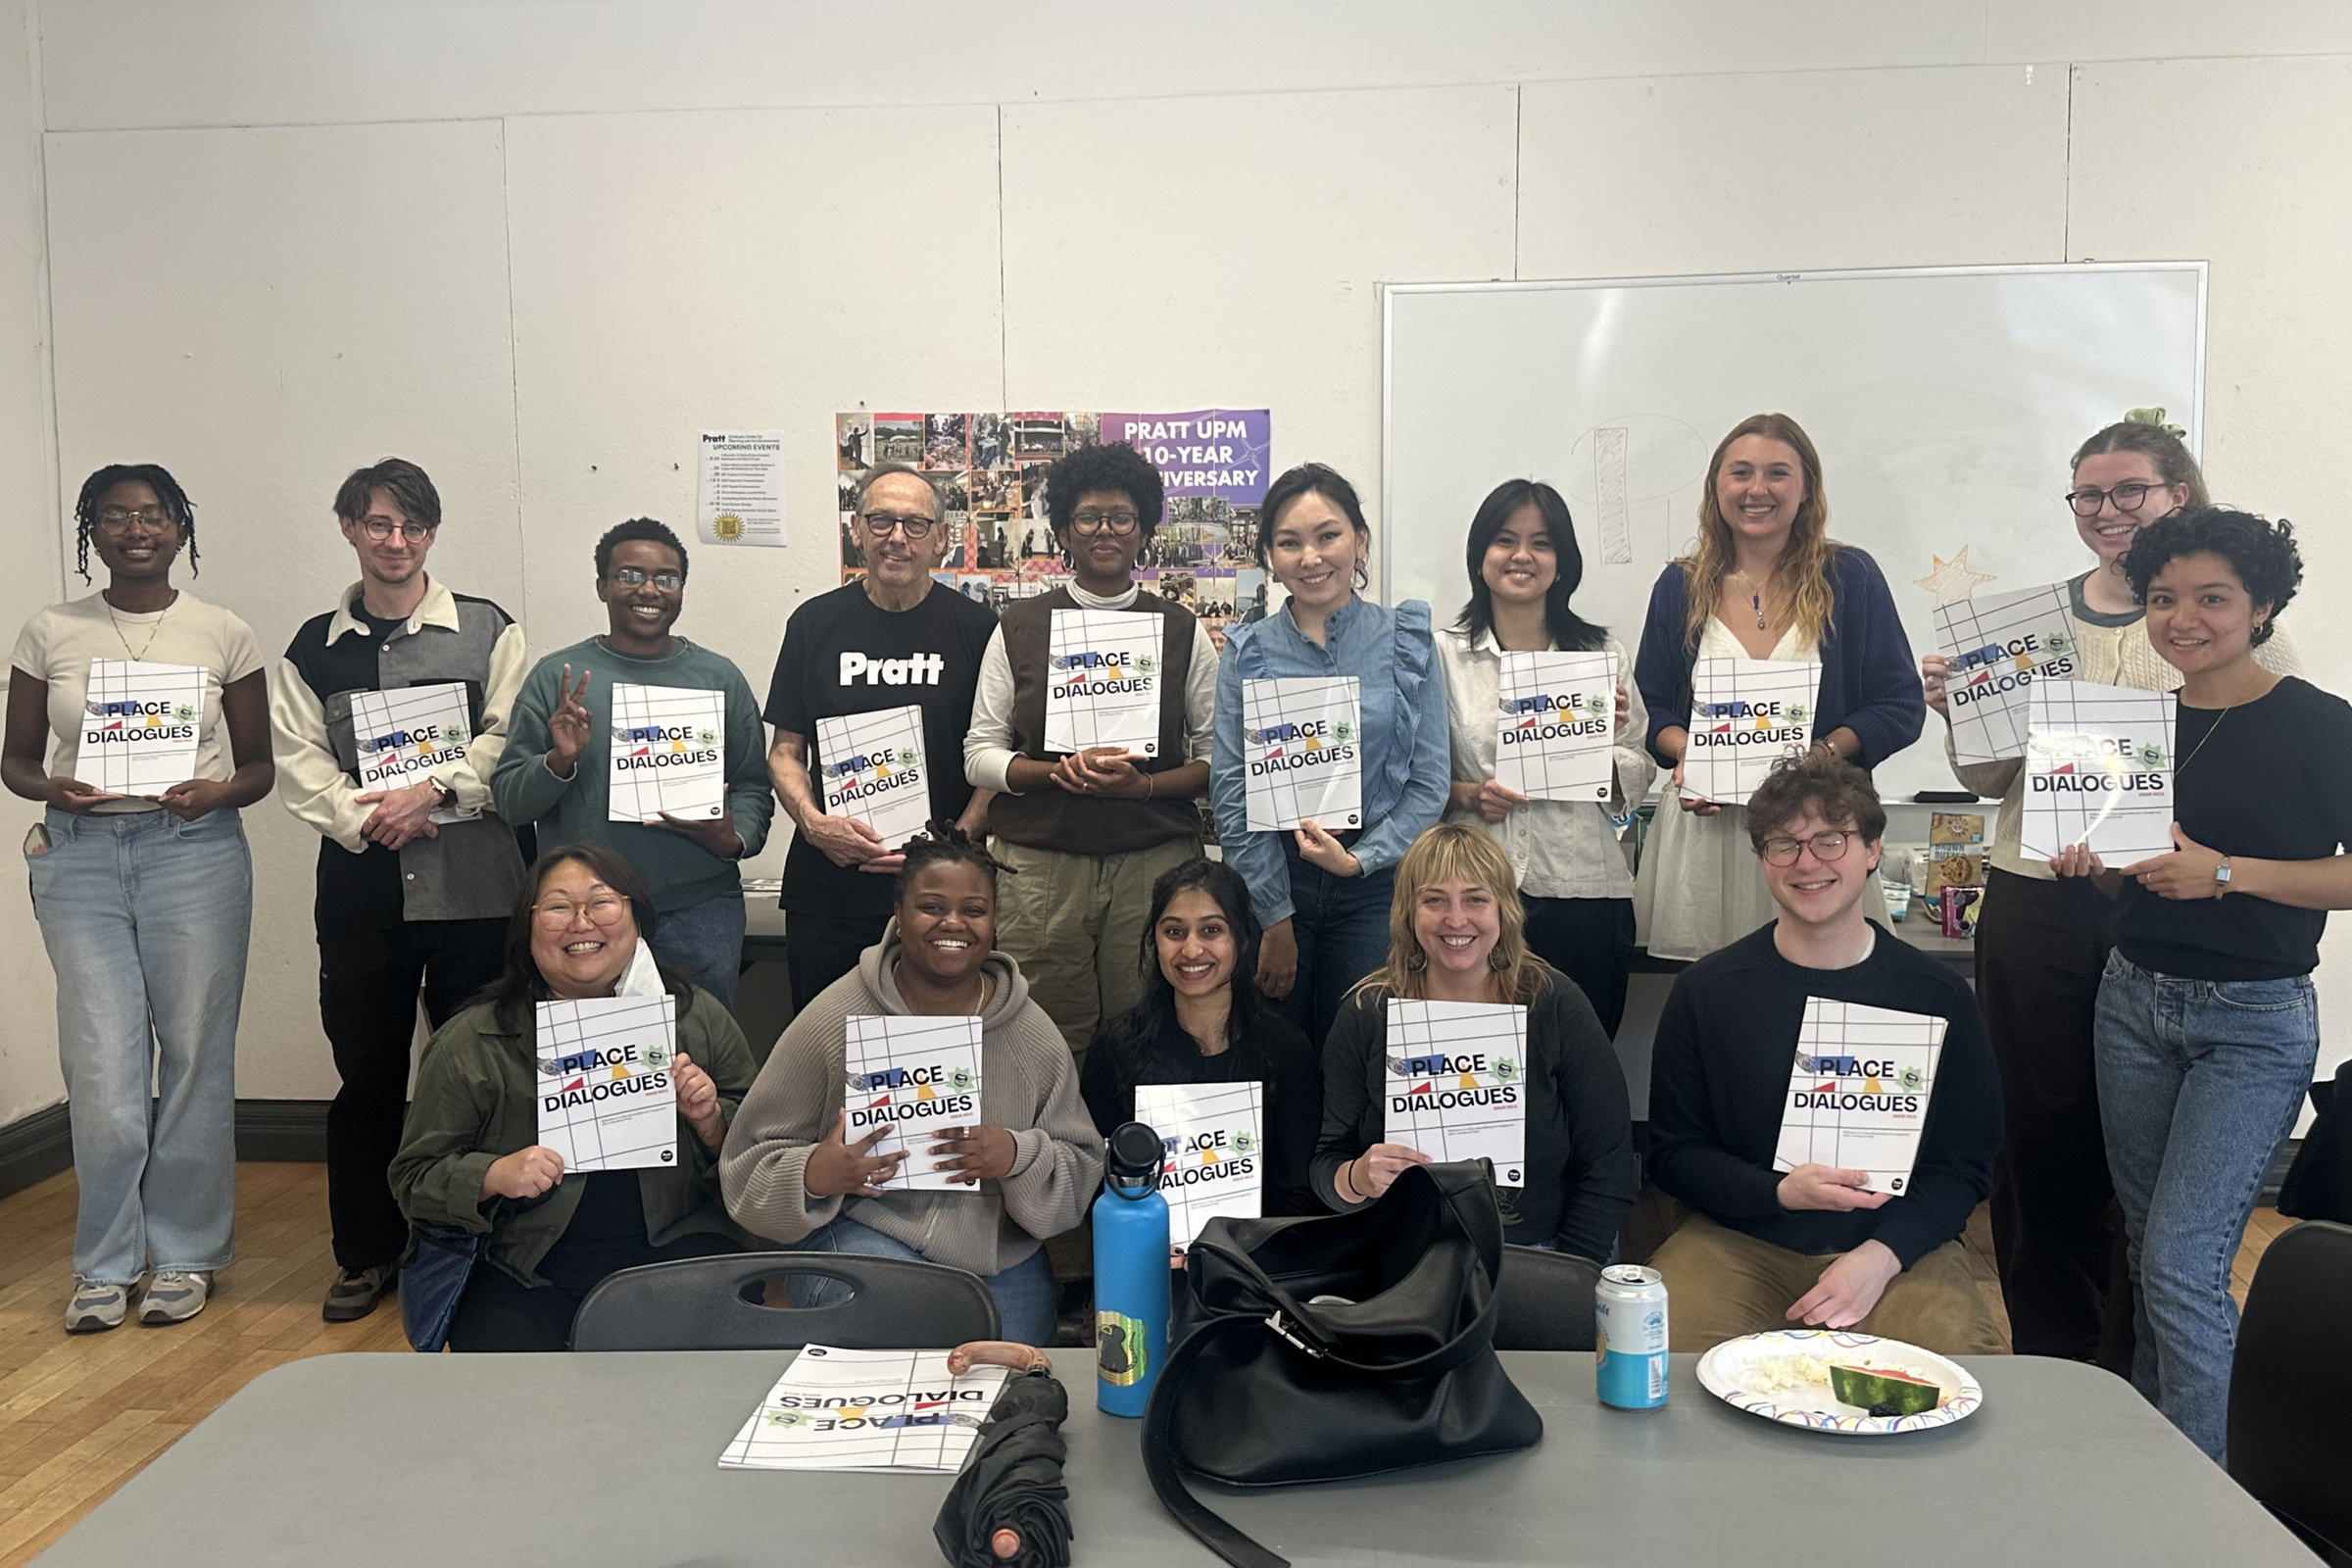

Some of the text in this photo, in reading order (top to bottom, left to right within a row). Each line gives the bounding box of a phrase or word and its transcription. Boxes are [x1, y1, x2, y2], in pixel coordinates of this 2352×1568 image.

[703, 434, 726, 443] Pratt
[1124, 420, 1248, 440] PRATT UPM
[1143, 446, 1234, 465] 10-YEAR
[1158, 469, 1259, 487] IVERSARY
[1069, 652, 1131, 669] PLACE
[1965, 634, 2039, 670] PLACE
[840, 652, 945, 686] Pratt
[1054, 677, 1153, 699] DIALOGUES
[108, 702, 171, 717] PLACE
[1519, 693, 1583, 714] PLACE
[1715, 702, 1781, 718] PLACE
[87, 726, 193, 744] DIALOGUES
[377, 725, 439, 752] PLACE
[633, 726, 693, 743] PLACE
[1266, 720, 1328, 744] PLACE
[1502, 719, 1607, 745] DIALOGUES
[1694, 727, 1804, 747] DIALOGUES
[366, 746, 466, 782] DIALOGUES
[616, 750, 717, 770] DIALOGUES
[840, 749, 895, 776] PLACE
[1250, 746, 1354, 777] DIALOGUES
[829, 769, 919, 808] DIALOGUES
[2032, 774, 2164, 792] DIALOGUES
[563, 1045, 638, 1075] PLACE
[1411, 1054, 1487, 1077] PLACE
[1820, 1059, 1894, 1078] PLACE
[870, 1065, 944, 1091] PLACE
[544, 1073, 667, 1112] DIALOGUES
[1393, 1087, 1517, 1113] DIALOGUES
[1794, 1093, 1918, 1112] DIALOGUES
[852, 1095, 973, 1127] DIALOGUES
[1164, 1130, 1227, 1156] LACE
[1156, 1158, 1253, 1191] ALOGUES
[780, 1390, 983, 1409] DIALOGUES
[813, 1412, 940, 1432] PLACE
